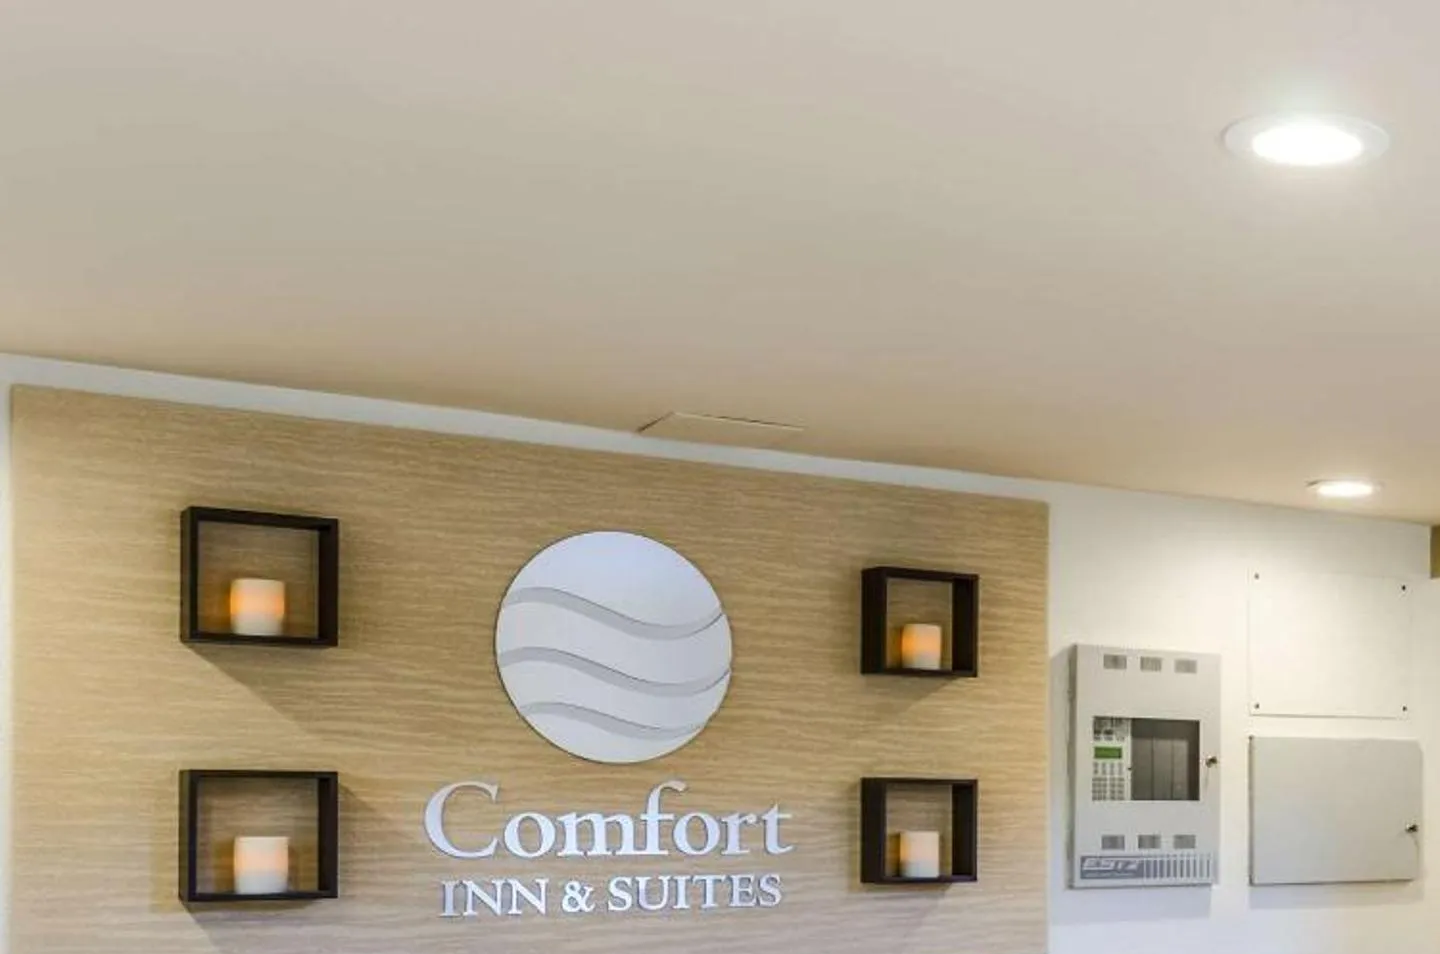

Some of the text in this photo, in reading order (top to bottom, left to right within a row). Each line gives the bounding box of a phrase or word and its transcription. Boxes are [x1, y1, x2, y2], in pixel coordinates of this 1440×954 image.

[423, 779, 794, 859] Comfort
[440, 873, 783, 918] INN & SUITES
